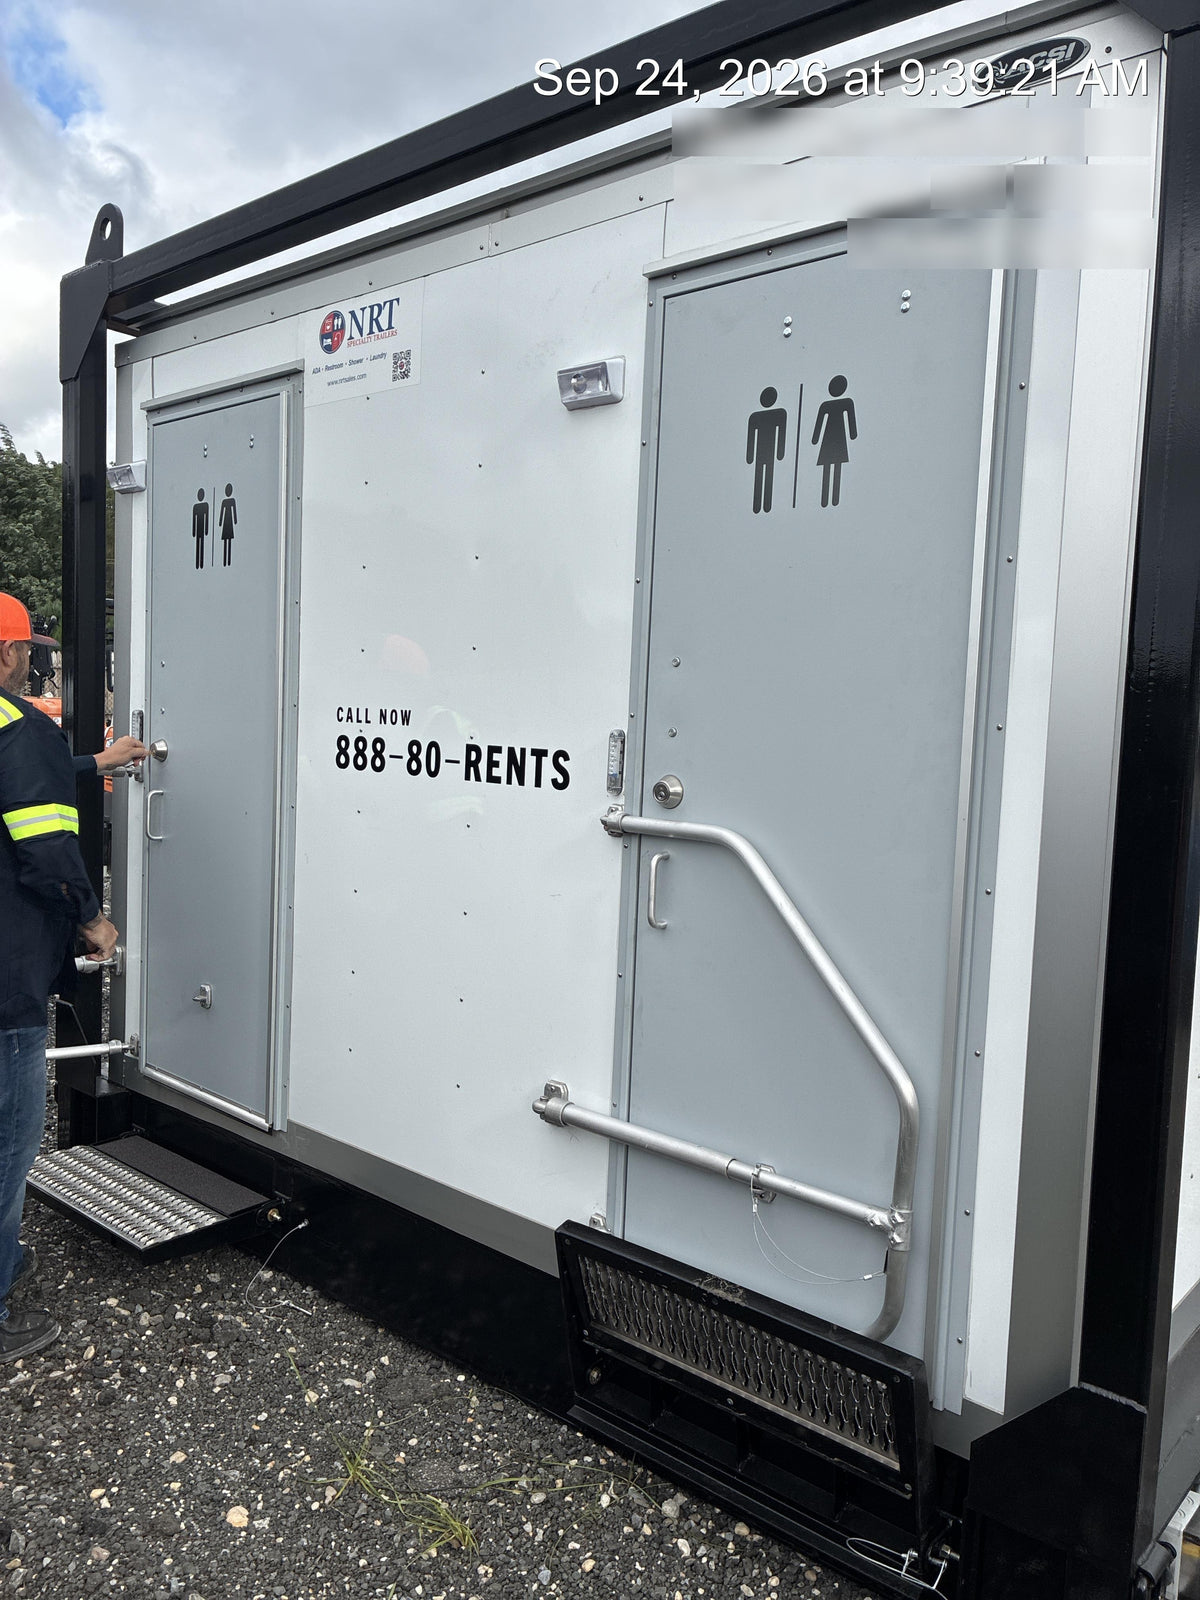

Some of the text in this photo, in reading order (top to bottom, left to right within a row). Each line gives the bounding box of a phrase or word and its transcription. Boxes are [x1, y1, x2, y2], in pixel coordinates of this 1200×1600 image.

[347, 298, 400, 340] NRT
[347, 329, 398, 348] SPECIALTY TRAILERS
[325, 362, 343, 372] Restroom
[348, 358, 364, 367] Shower
[369, 352, 387, 361] Laundry
[336, 706, 412, 726] CALL NOW
[335, 734, 571, 791] 888-80-RENTS
